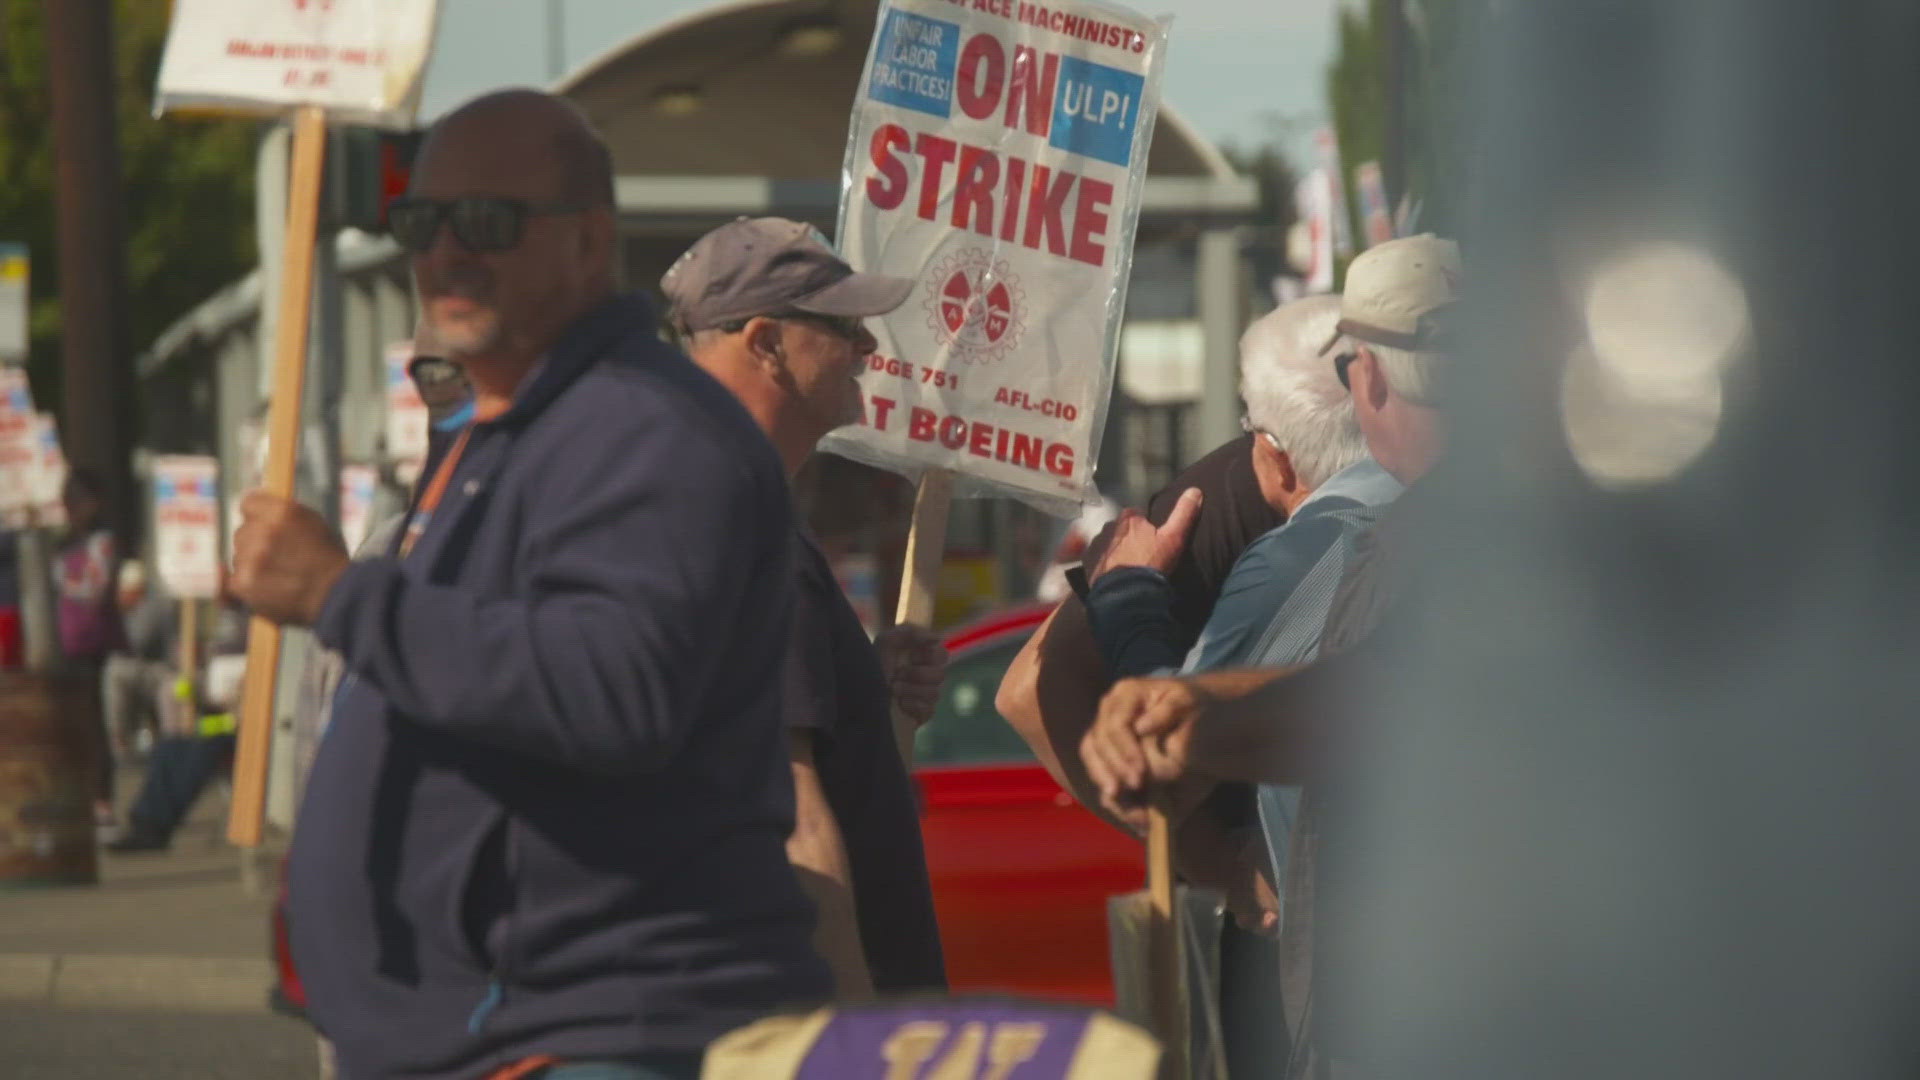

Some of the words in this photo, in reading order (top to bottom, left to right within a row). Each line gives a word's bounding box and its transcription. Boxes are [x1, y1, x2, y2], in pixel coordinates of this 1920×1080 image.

[894, 16, 943, 47] UNFAIR
[1018, 3, 1146, 53] MACHINISTS
[873, 61, 950, 100] PRACTICES!
[891, 44, 937, 71] LABOR
[958, 33, 1059, 138] ON
[1063, 80, 1129, 129] ULP!
[866, 124, 1113, 266] STRIKE
[863, 354, 914, 380] DGE
[921, 367, 958, 390] 751
[994, 387, 1077, 422] AFL-CIO
[908, 405, 1074, 477] BOEING
